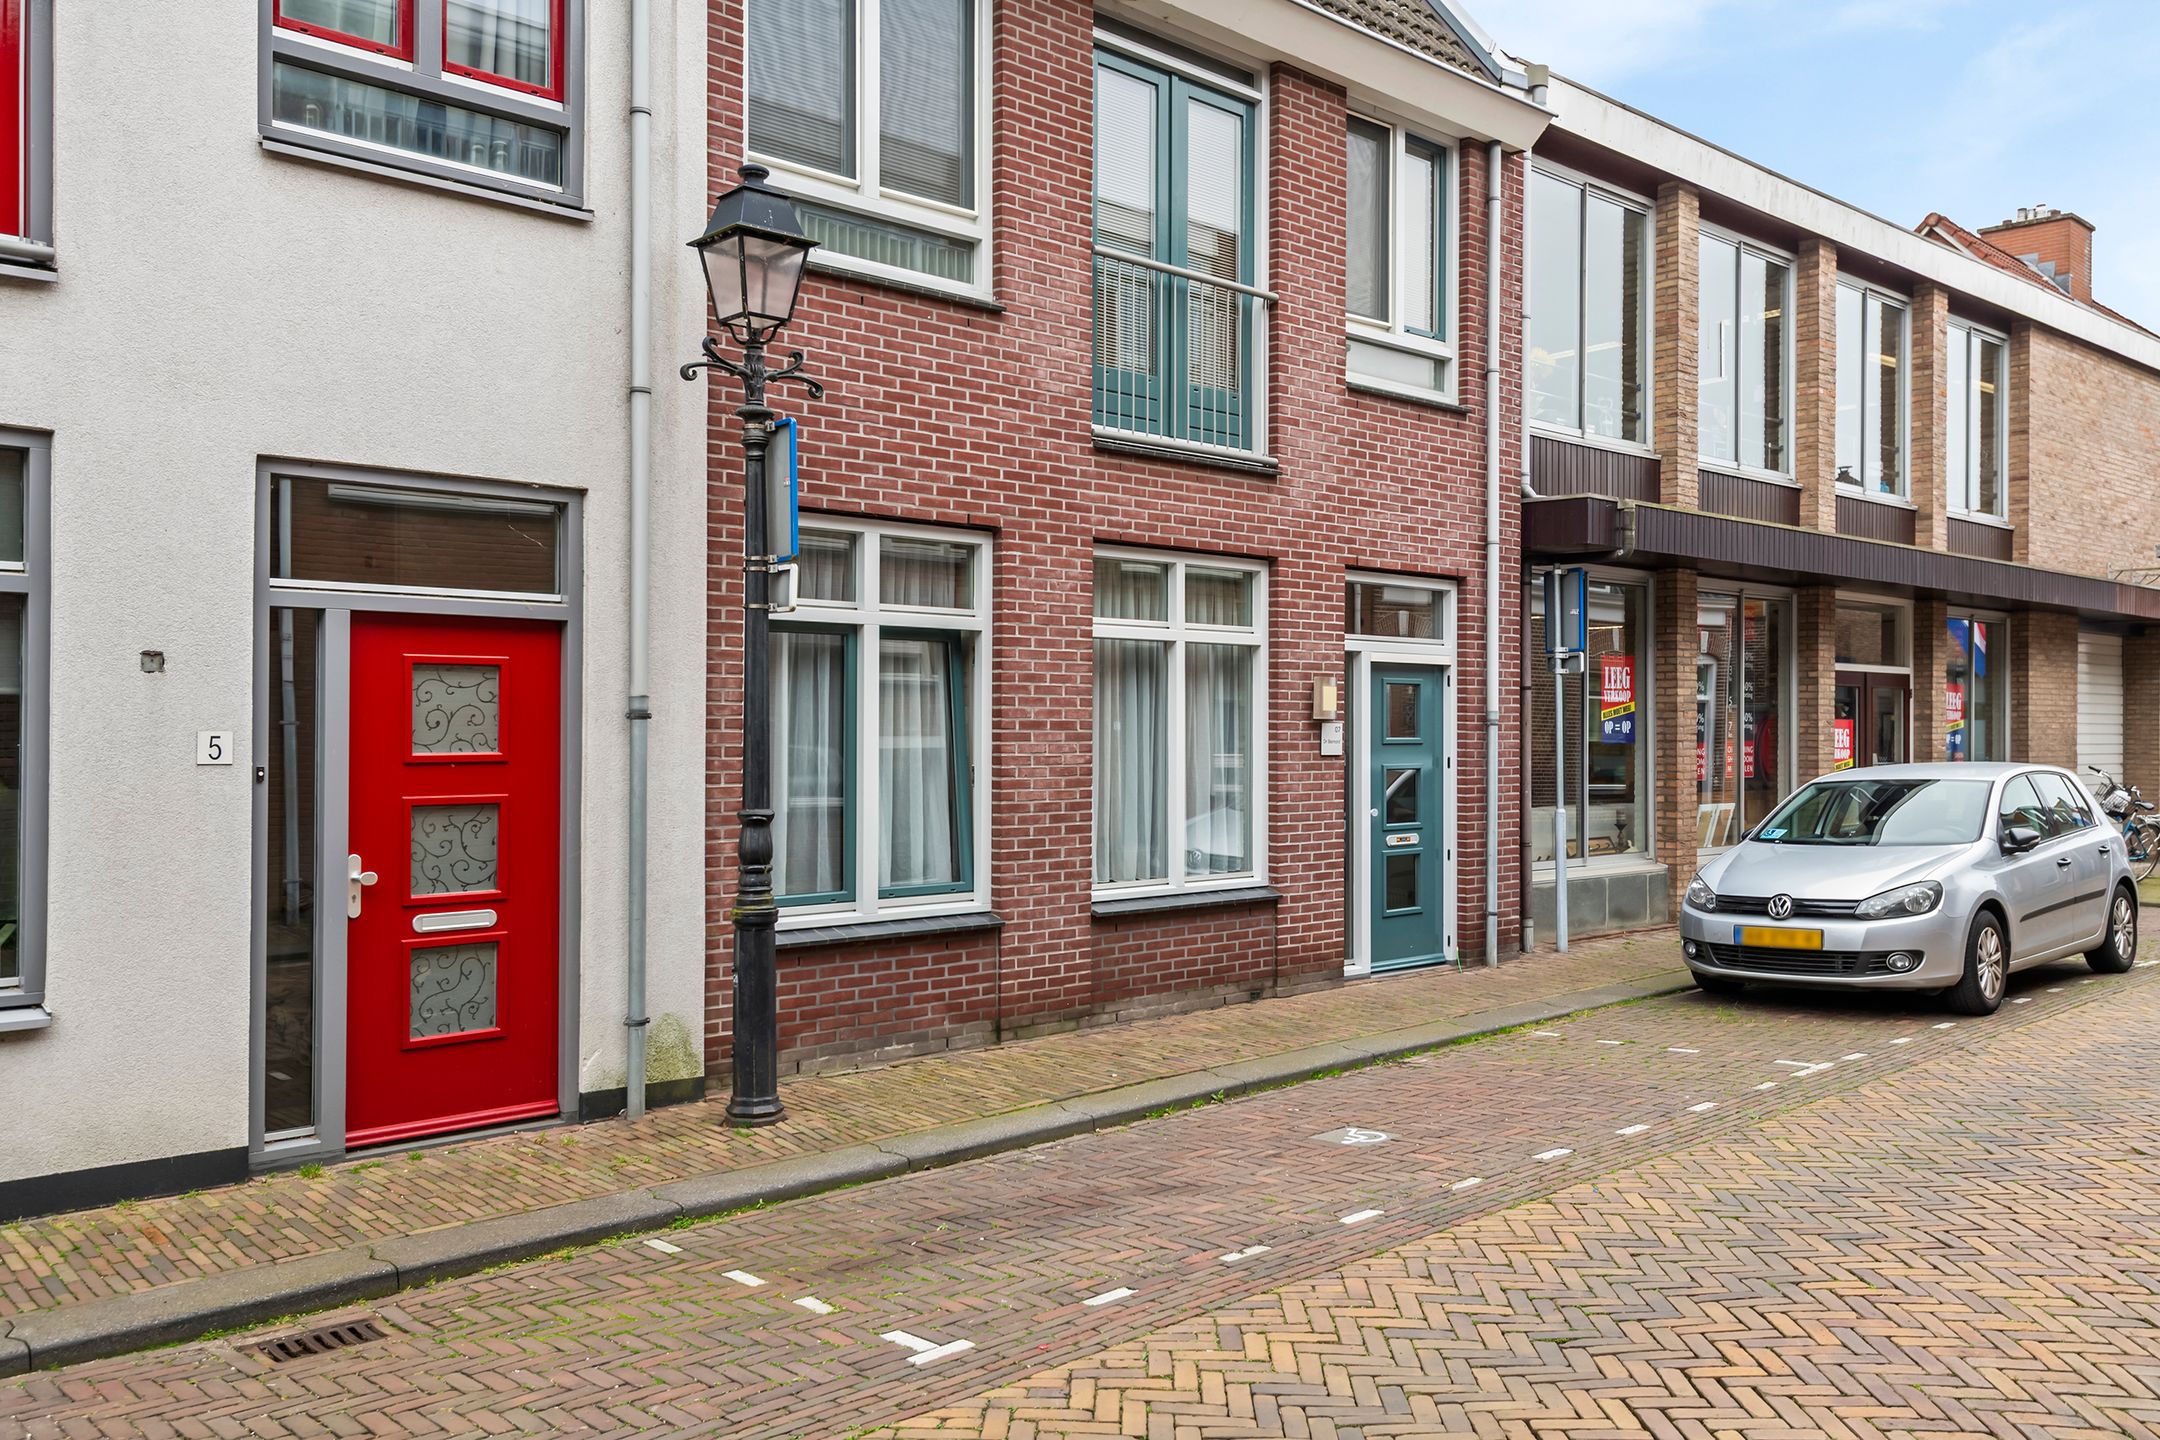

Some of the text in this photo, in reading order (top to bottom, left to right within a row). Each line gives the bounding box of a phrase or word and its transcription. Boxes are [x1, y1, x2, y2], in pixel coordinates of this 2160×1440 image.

[1604, 666, 1631, 689] LEEG
[1604, 690, 1632, 702] VERKOOP
[1604, 720, 1614, 734] OP
[1621, 720, 1632, 734] OP
[208, 735, 222, 760] 5
[1834, 728, 1850, 748] EEG
